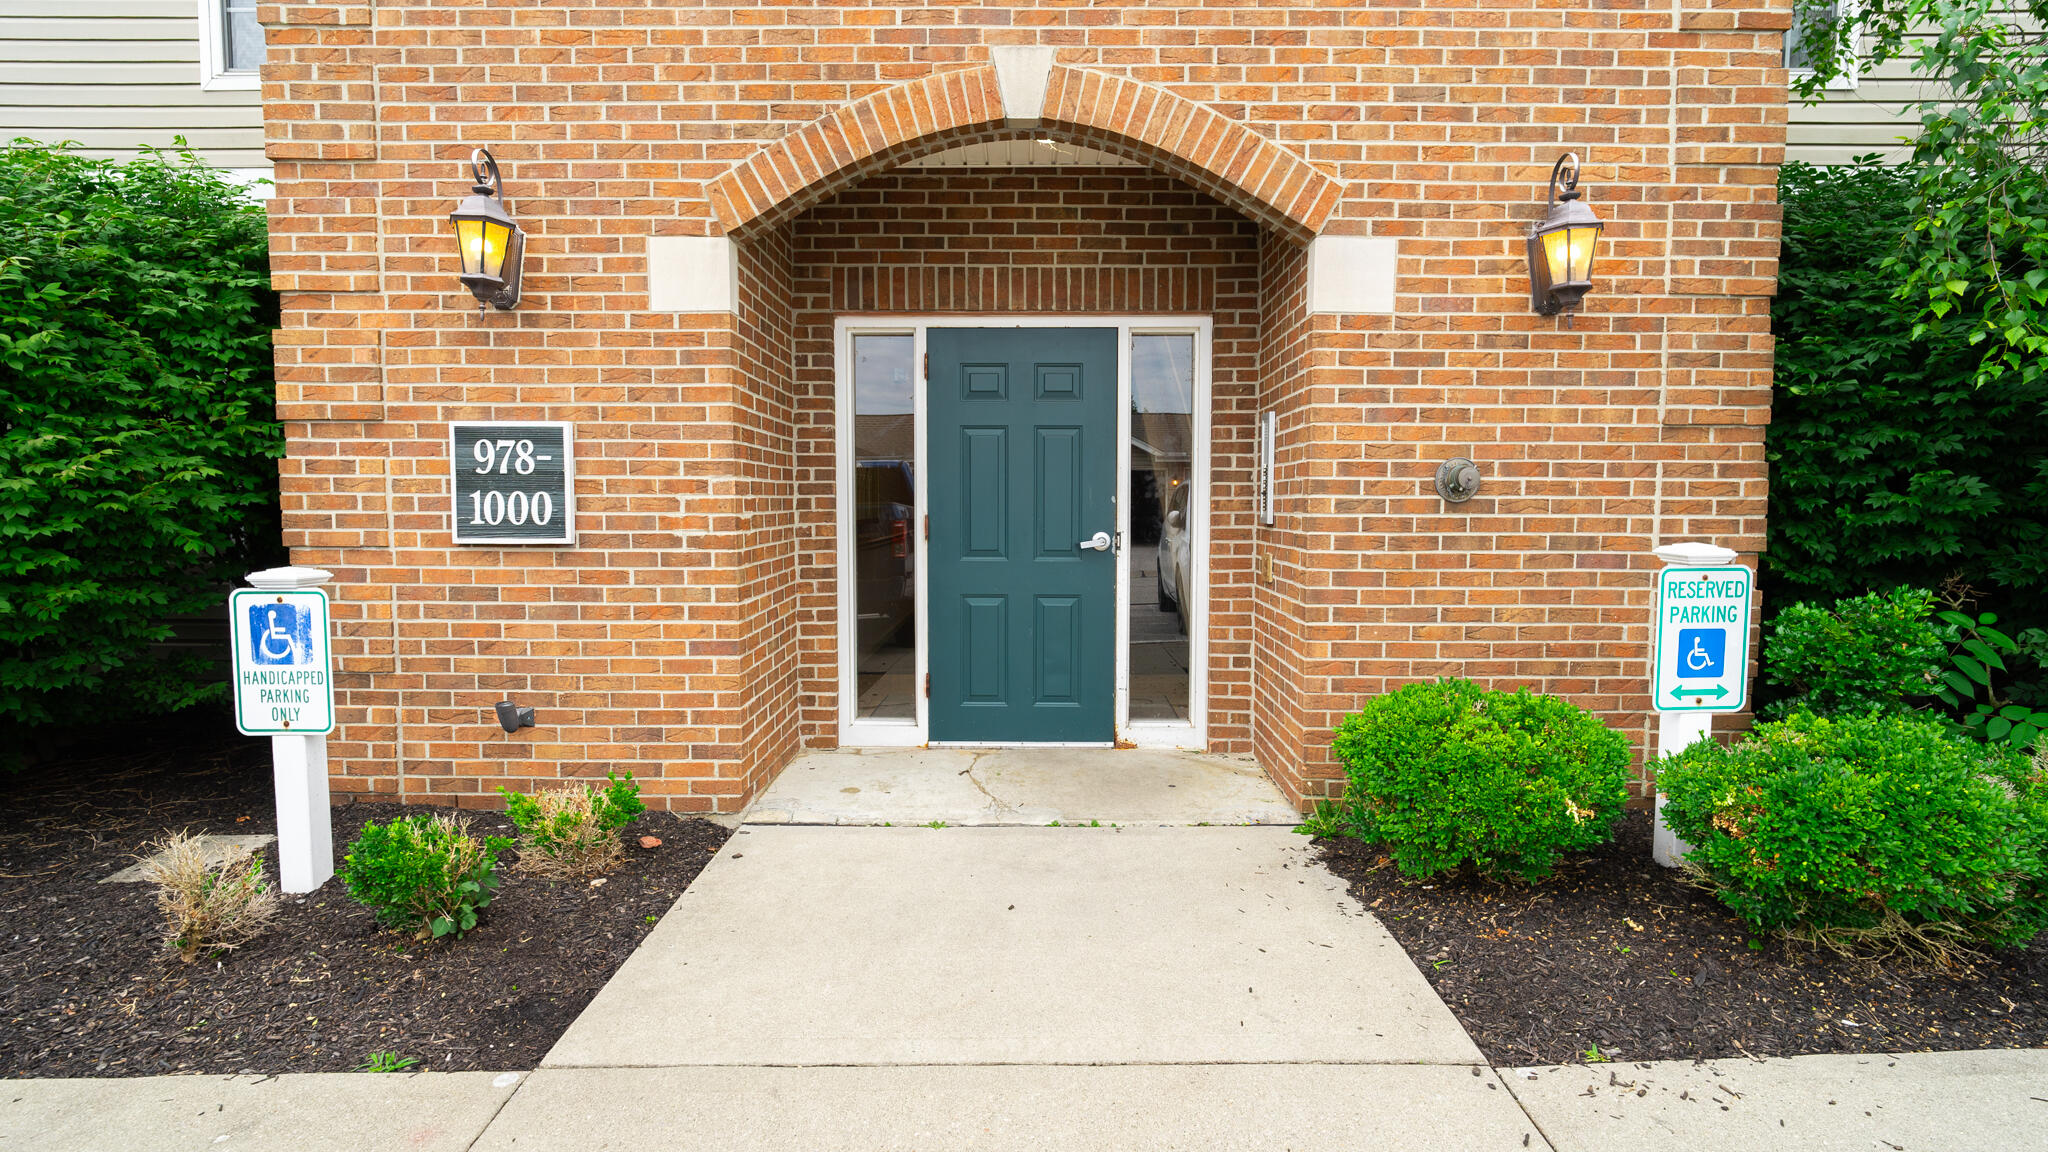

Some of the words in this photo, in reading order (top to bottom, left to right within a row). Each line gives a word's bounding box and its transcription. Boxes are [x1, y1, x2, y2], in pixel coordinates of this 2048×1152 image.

[474, 439, 552, 475] 978-
[469, 490, 553, 526] 1000
[1668, 580, 1745, 599] RESERVED
[1670, 605, 1738, 624] PARKING
[243, 670, 324, 685] HANDICAPPED
[260, 688, 310, 704] PARKING
[271, 707, 301, 722] ONLY
